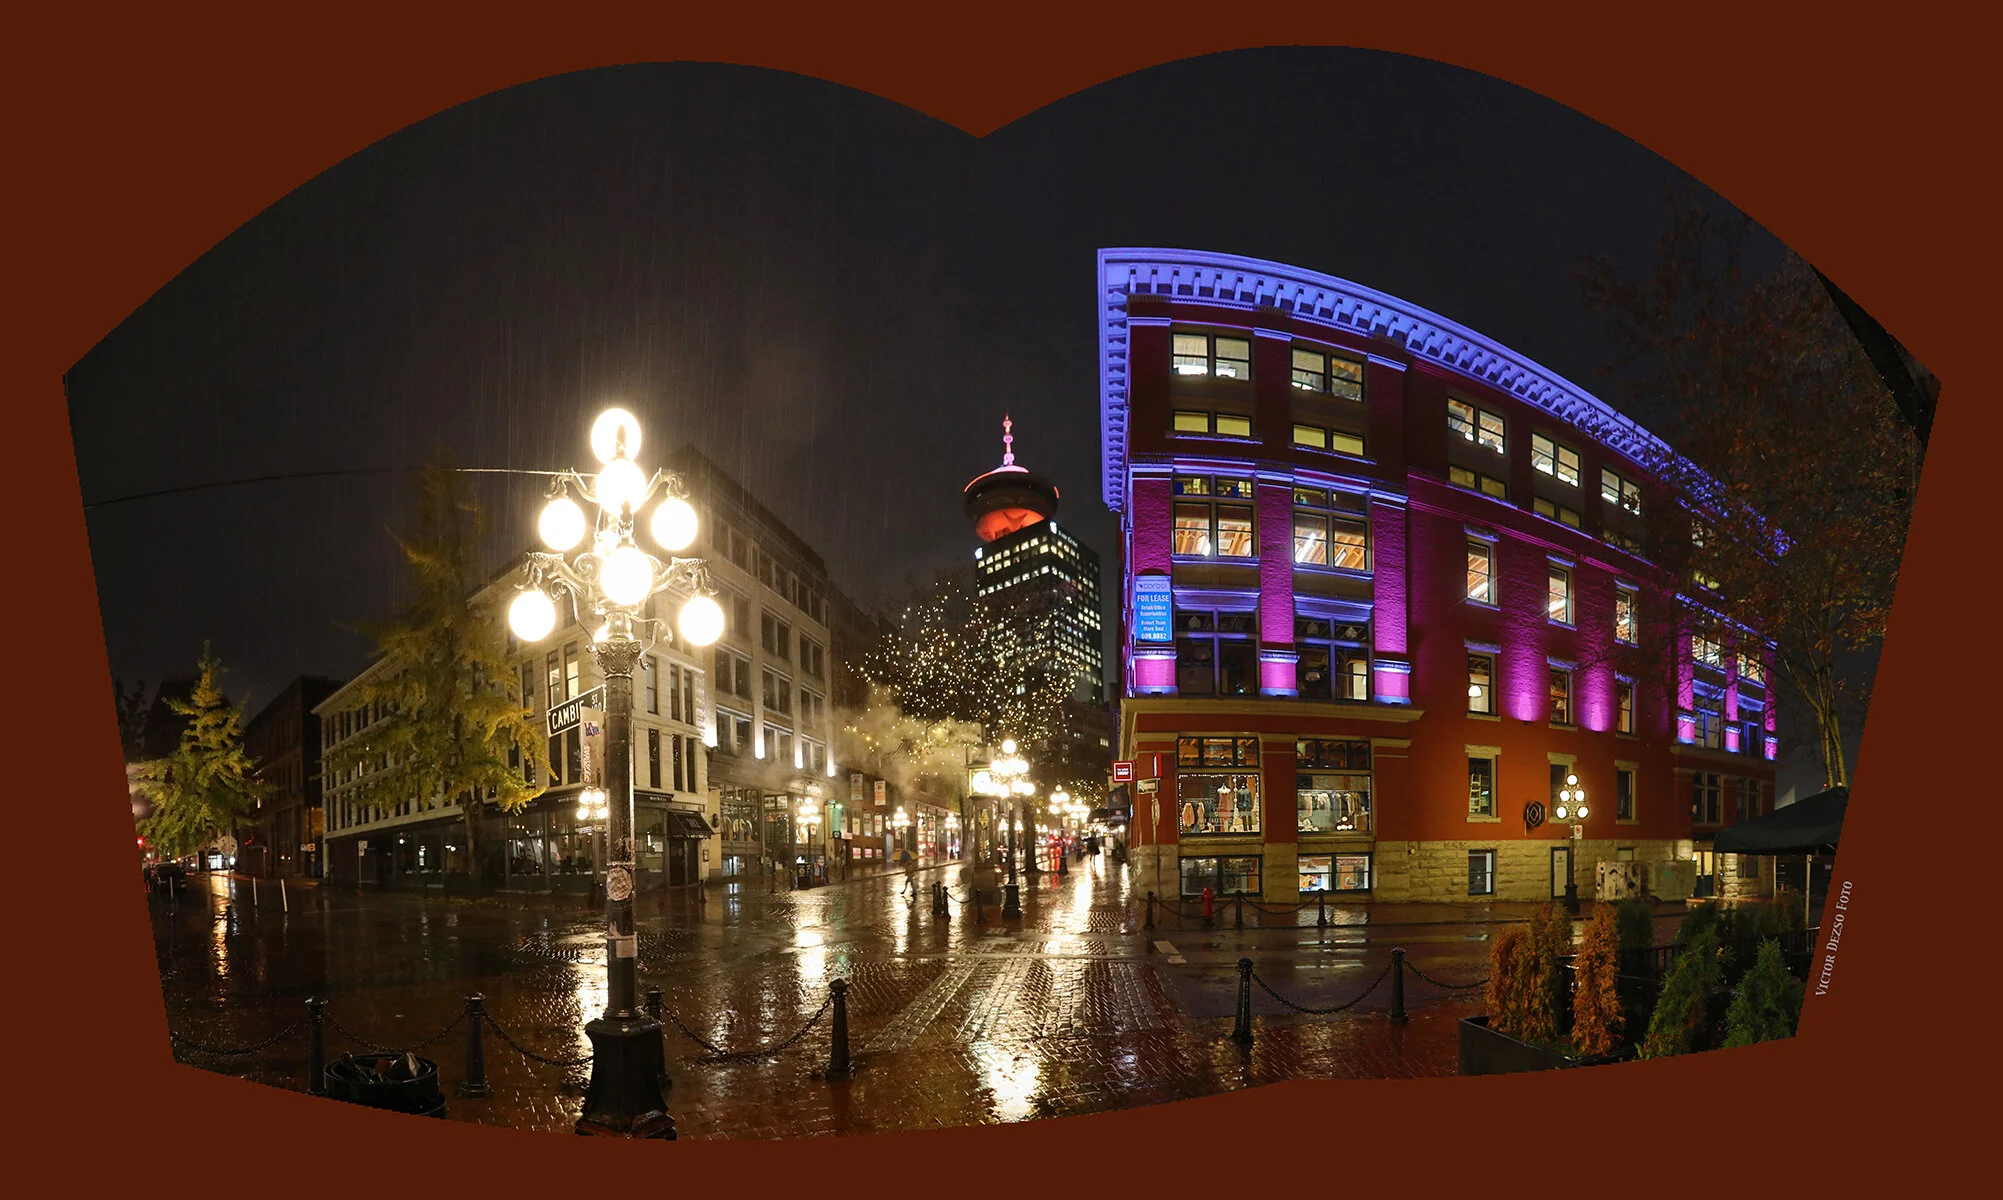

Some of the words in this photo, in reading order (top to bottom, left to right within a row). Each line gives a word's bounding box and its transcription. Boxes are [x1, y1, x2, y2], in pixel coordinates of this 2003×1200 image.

[1137, 594, 1149, 602] FOR
[1150, 594, 1169, 602] LEASE
[591, 693, 598, 705] ST
